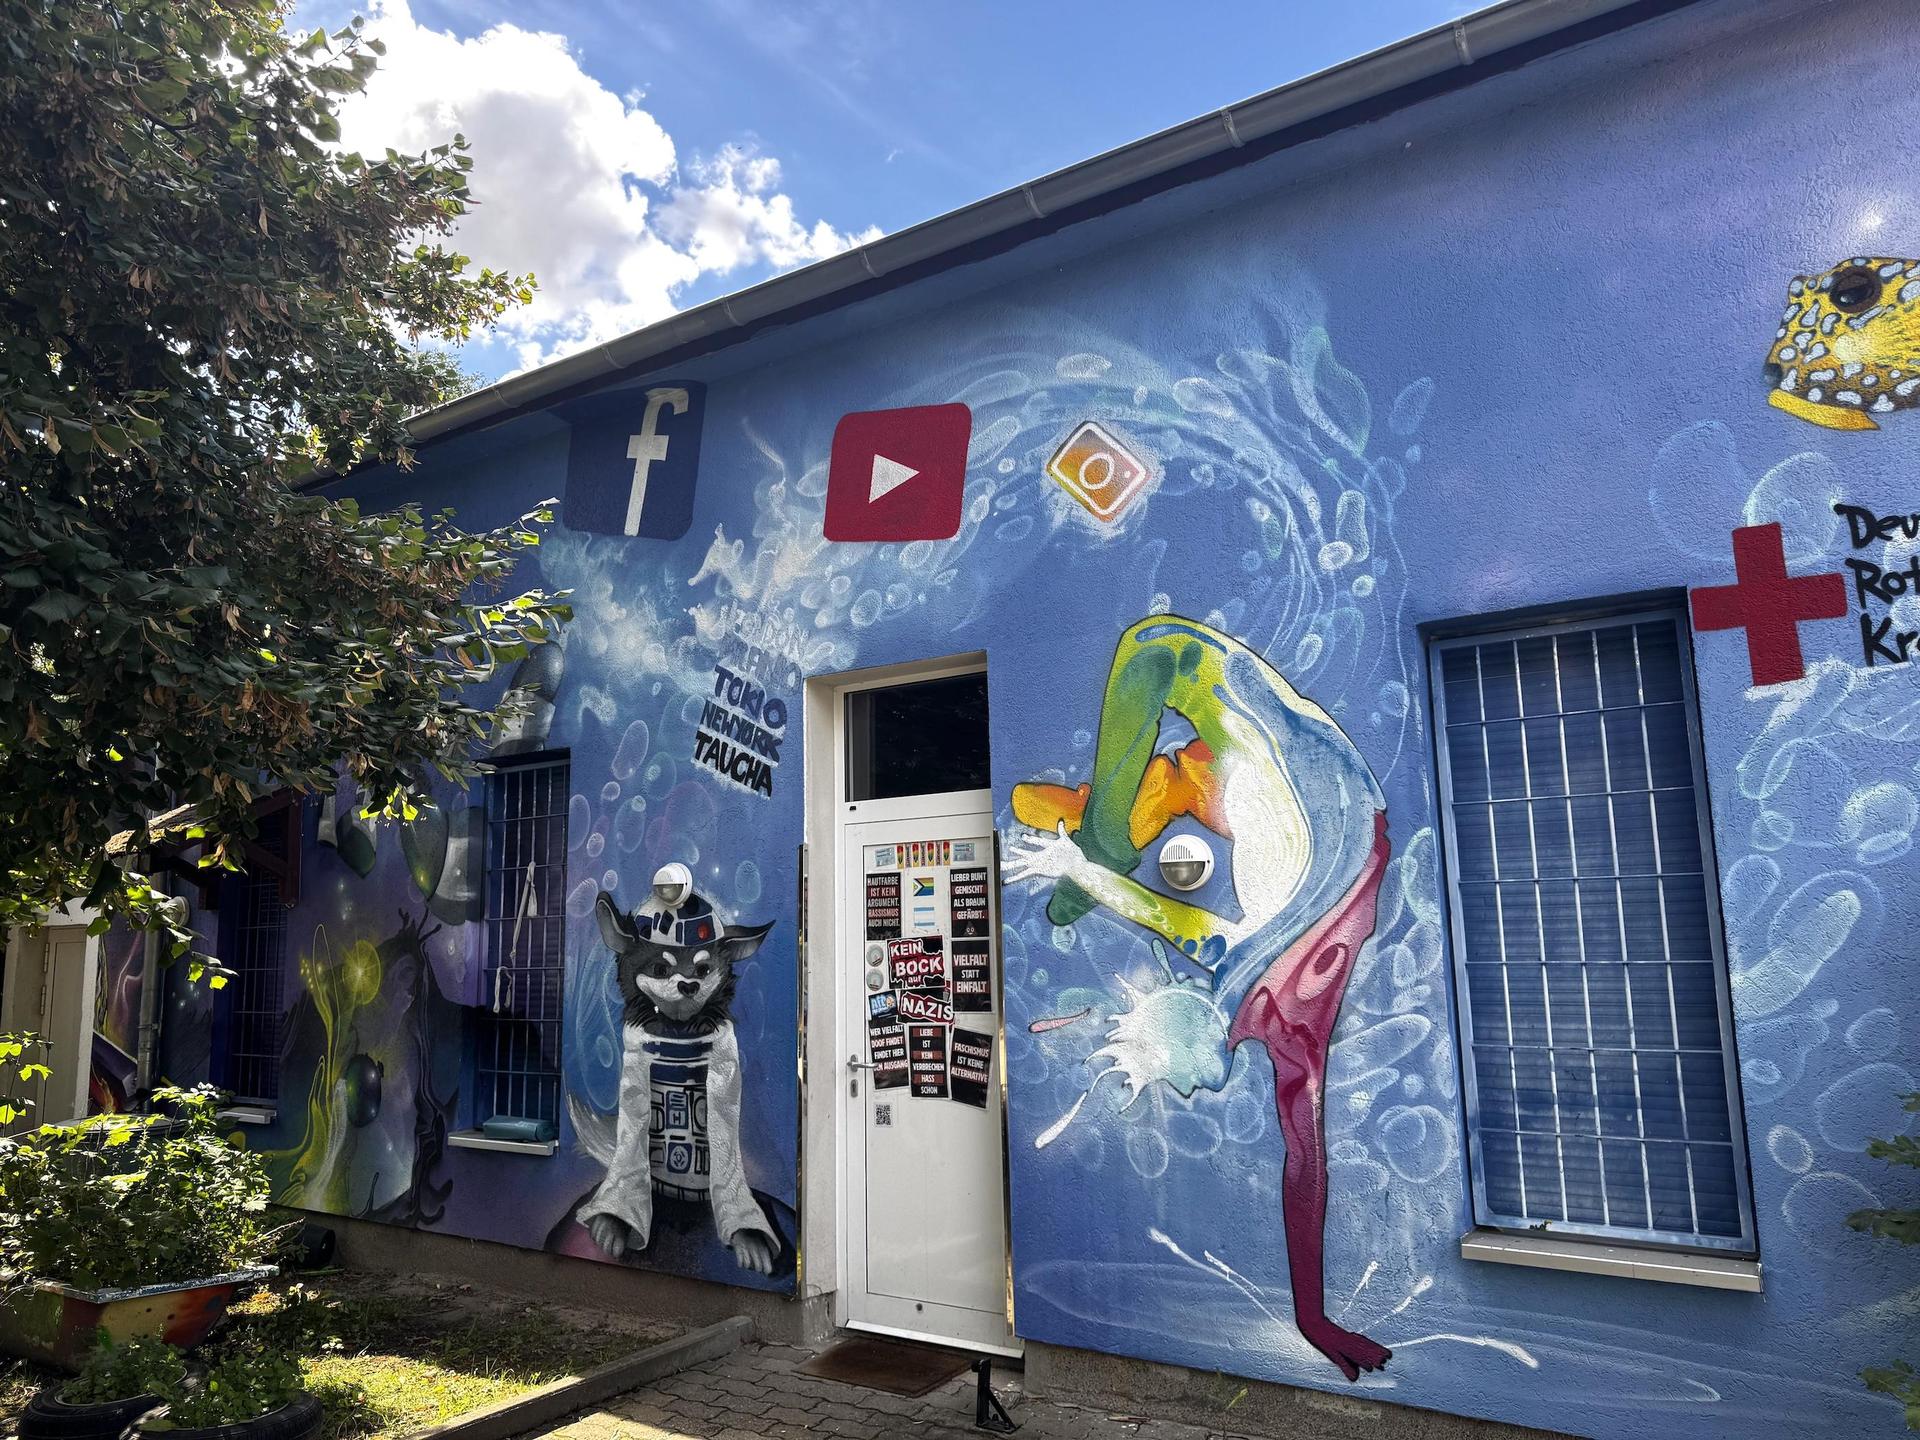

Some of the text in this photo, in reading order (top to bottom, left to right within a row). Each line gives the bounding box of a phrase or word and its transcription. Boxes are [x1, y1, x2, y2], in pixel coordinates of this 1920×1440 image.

[1860, 613, 1920, 667] Kr
[714, 664, 788, 729] TOKIO
[695, 730, 772, 797] TAUCHA
[867, 877, 899, 886] HAUTFARBE
[951, 872, 987, 882] LIEBER BUNT
[870, 887, 896, 897] IST KEIN
[955, 885, 983, 894] GEMISCHT
[954, 898, 986, 907] ALS BRAUN
[868, 908, 899, 918] RASSISMUS
[868, 919, 882, 928] AUCH
[890, 942, 922, 957] KEIN
[953, 954, 988, 966] VIELFALT
[895, 957, 943, 977] BOCK
[961, 969, 980, 979] STATT
[956, 981, 987, 993] EINFALT
[903, 998, 954, 1020] NAZIS
[870, 1025, 903, 1036] WER VIELFALT
[920, 1028, 934, 1036] LIEBE
[871, 1036, 903, 1048] DOOF FINDET
[922, 1040, 931, 1048] IST
[874, 1048, 904, 1059] FINDET HIER
[921, 1051, 933, 1059] KEIN
[954, 1042, 989, 1058] FASCHISMUS
[884, 1060, 908, 1070] AUSGANG
[912, 1063, 945, 1071] VERBRECHEN
[957, 1056, 984, 1069] IST KEINE
[921, 1074, 935, 1082] HASS
[951, 1067, 988, 1083] ALTERNATIVE
[921, 1086, 938, 1094] SCHON
